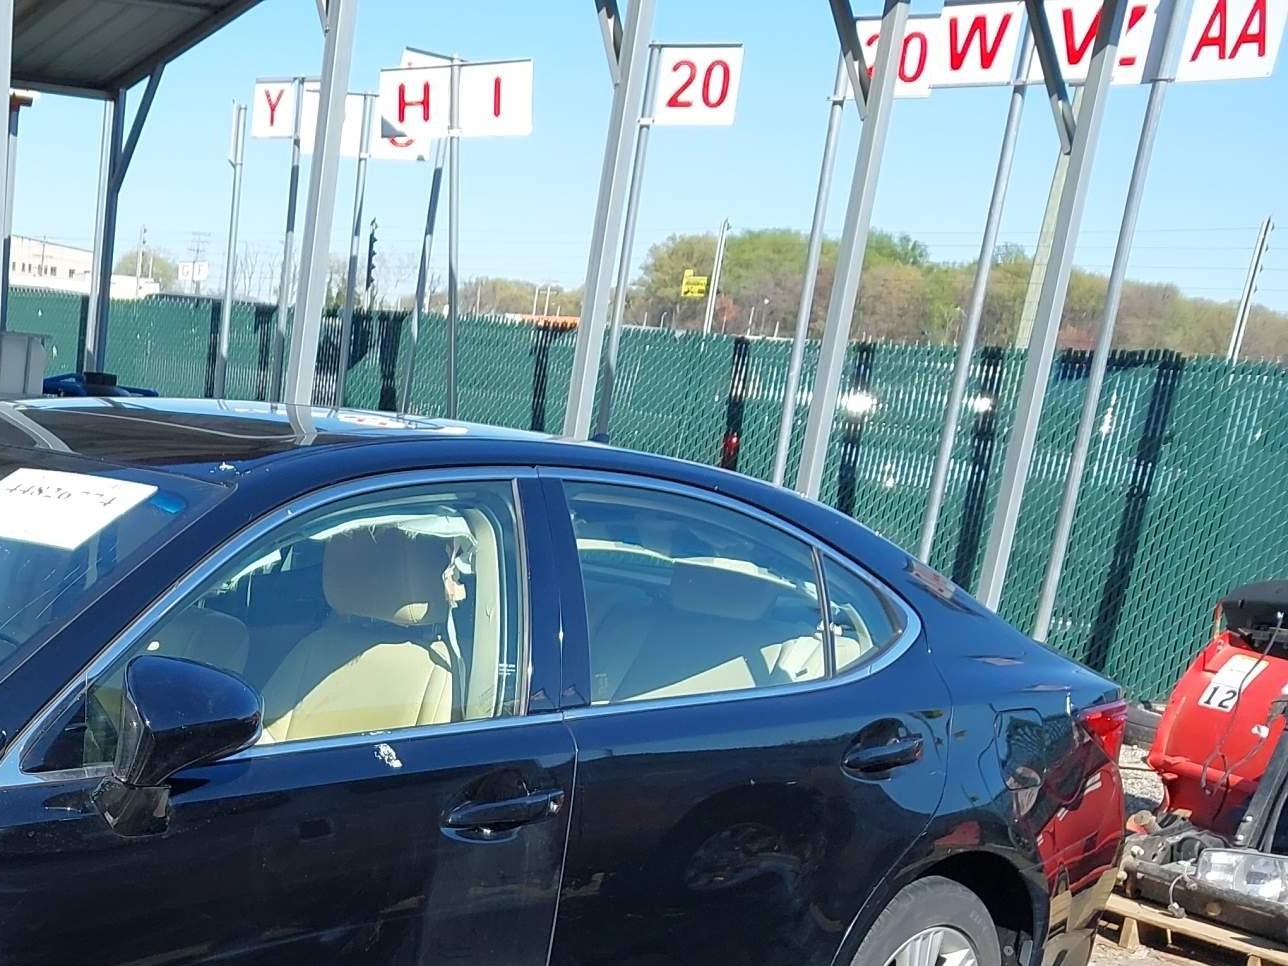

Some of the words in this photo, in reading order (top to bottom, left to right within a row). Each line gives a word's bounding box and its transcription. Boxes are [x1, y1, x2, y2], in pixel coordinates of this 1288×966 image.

[948, 12, 1013, 71] W
[1190, 0, 1268, 62] AA
[865, 31, 928, 83] 0
[398, 81, 431, 123] H
[492, 75, 502, 118] I
[666, 59, 731, 109] 20
[265, 88, 285, 127] Y
[1203, 685, 1238, 709] 12
